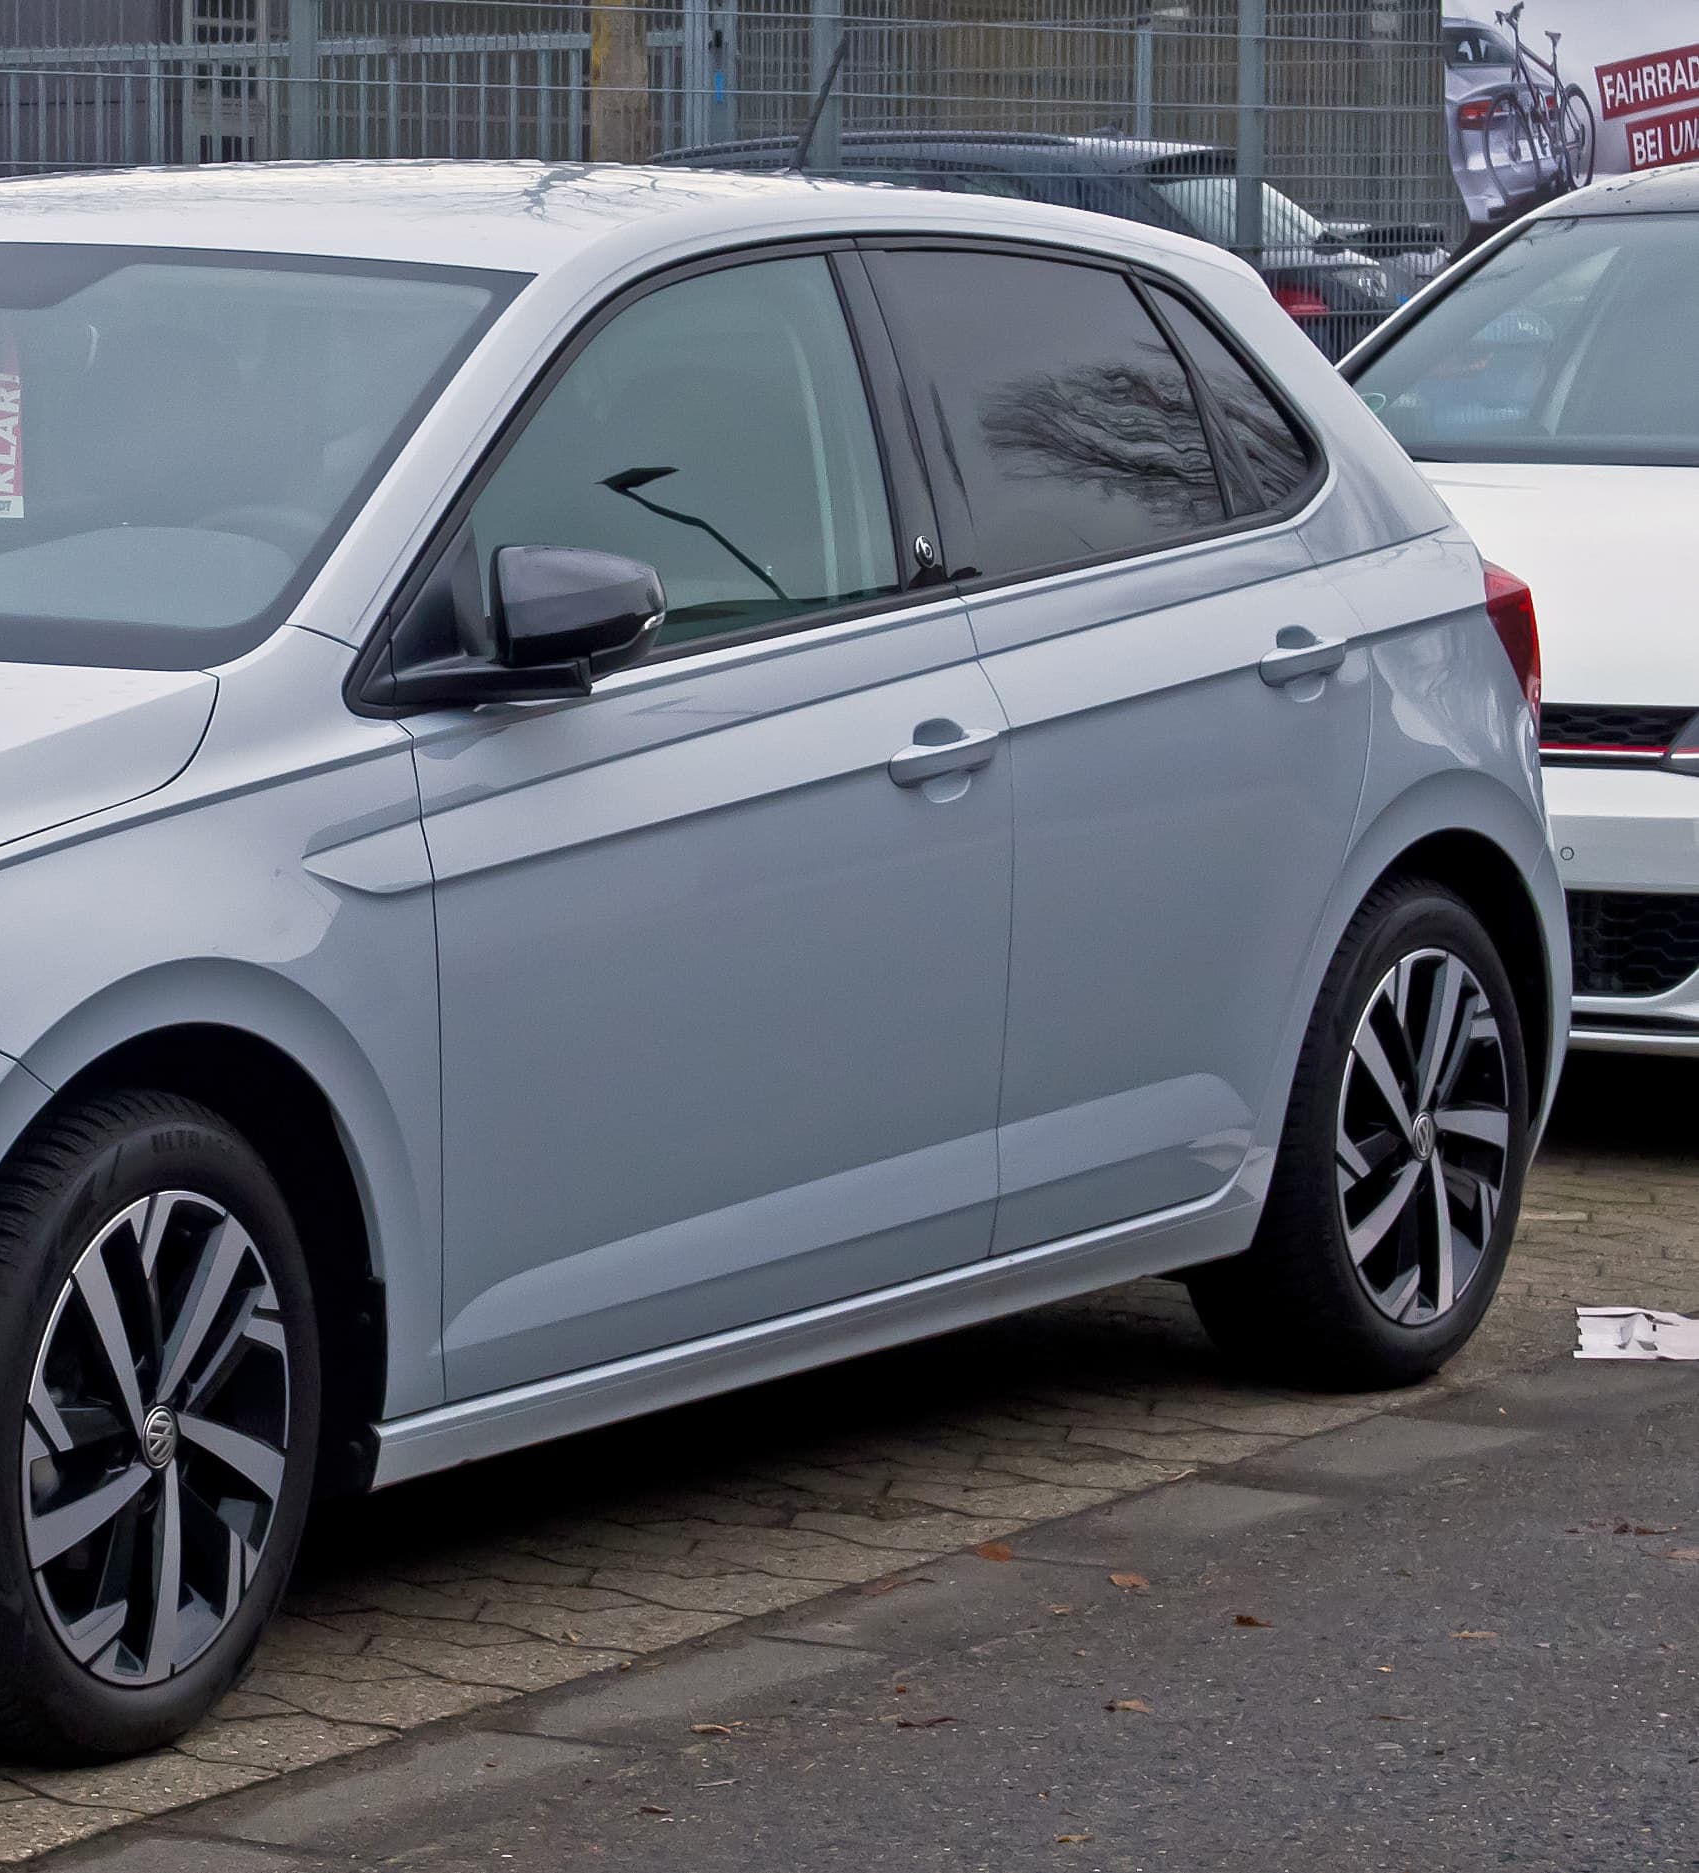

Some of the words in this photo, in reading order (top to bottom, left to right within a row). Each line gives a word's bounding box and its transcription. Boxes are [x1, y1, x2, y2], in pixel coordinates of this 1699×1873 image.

[1602, 55, 1699, 110] FAHRRAD
[1632, 127, 1664, 167] BEI
[1669, 117, 1699, 157] UN
